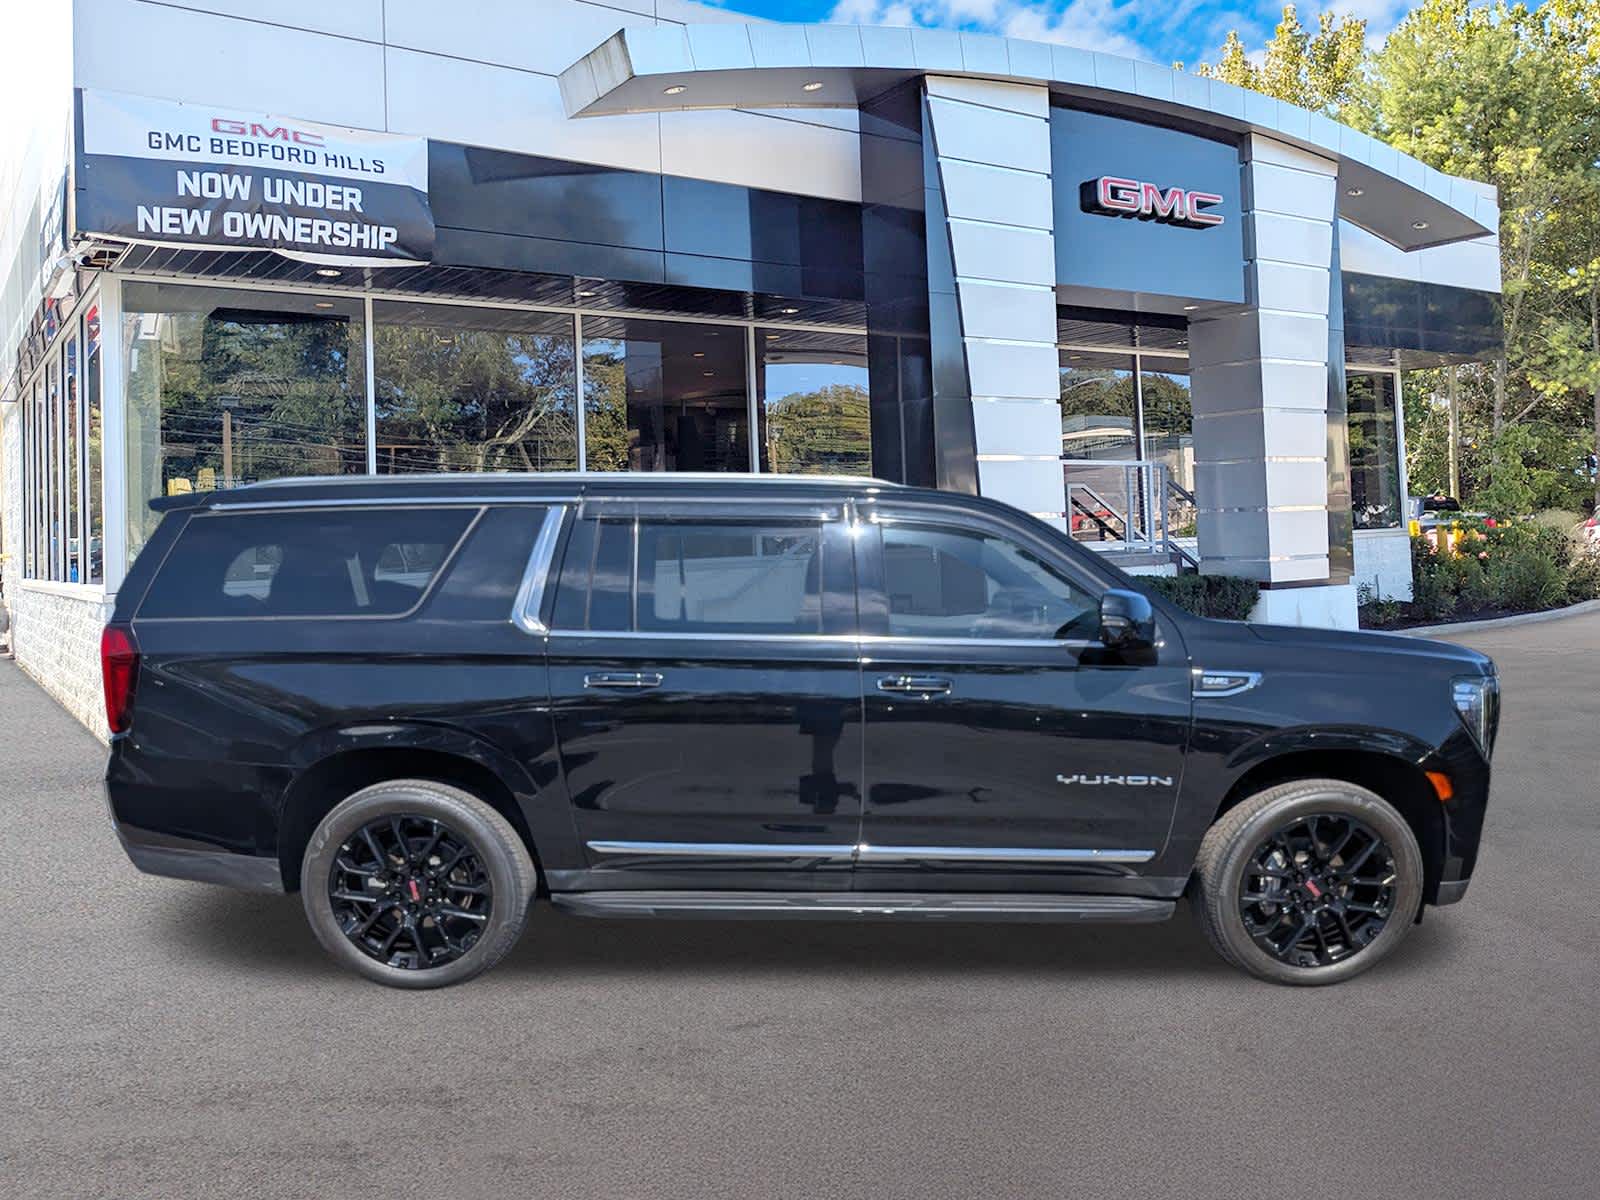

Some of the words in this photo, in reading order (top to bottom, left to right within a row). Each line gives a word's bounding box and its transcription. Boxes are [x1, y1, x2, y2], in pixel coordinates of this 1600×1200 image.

[148, 131, 201, 153] GMC
[210, 138, 317, 166] BEDFORD
[324, 153, 385, 174] HILLS
[211, 118, 326, 148] GMC
[177, 170, 252, 201] NOW
[263, 177, 363, 213] UNDER
[1097, 176, 1225, 225] GMC
[137, 205, 211, 236] NEW
[223, 211, 398, 250] OWNERSHIP
[1056, 774, 1172, 786] YUKON
